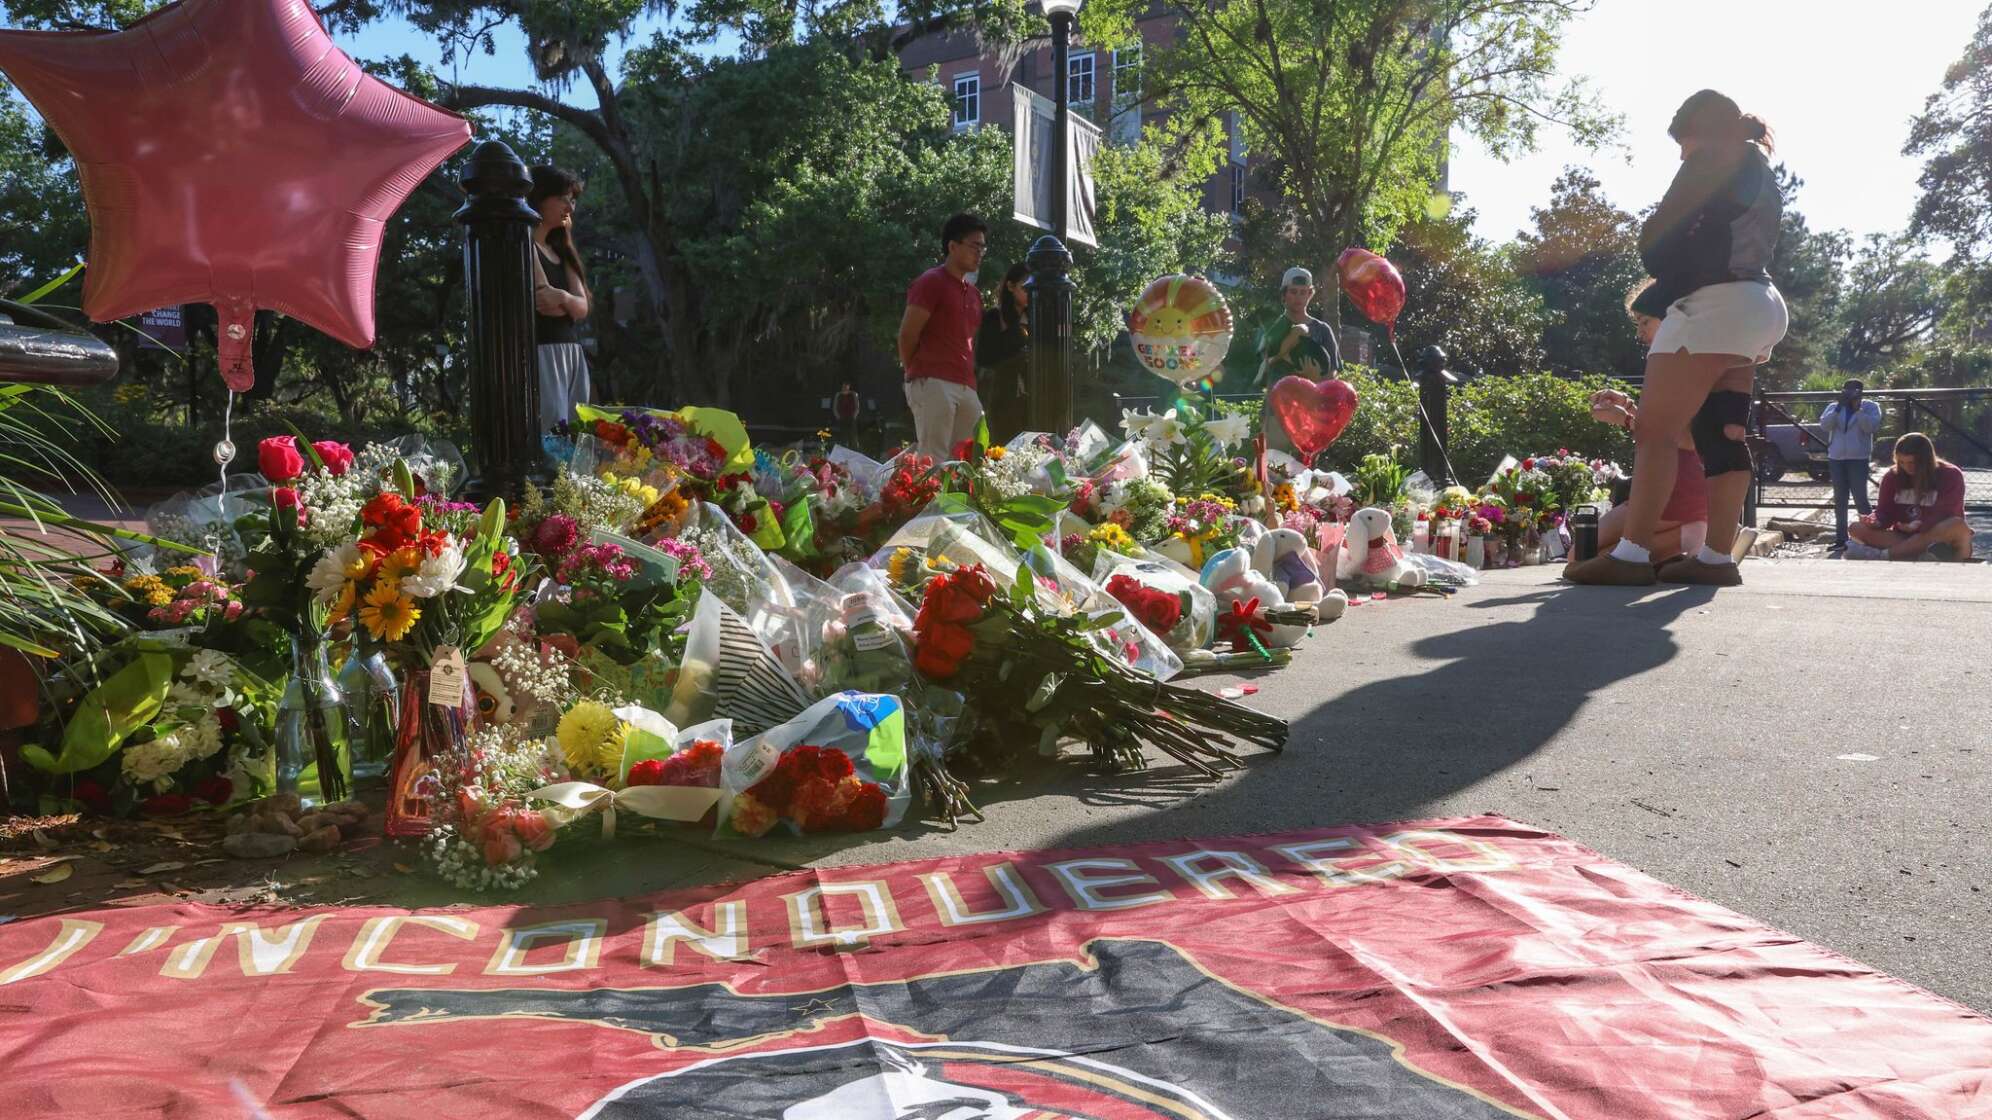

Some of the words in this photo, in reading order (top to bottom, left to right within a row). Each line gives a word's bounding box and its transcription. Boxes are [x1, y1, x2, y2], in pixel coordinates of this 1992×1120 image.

[152, 310, 181, 319] CHANGE
[143, 317, 155, 326] THE
[156, 318, 181, 327] WORLD
